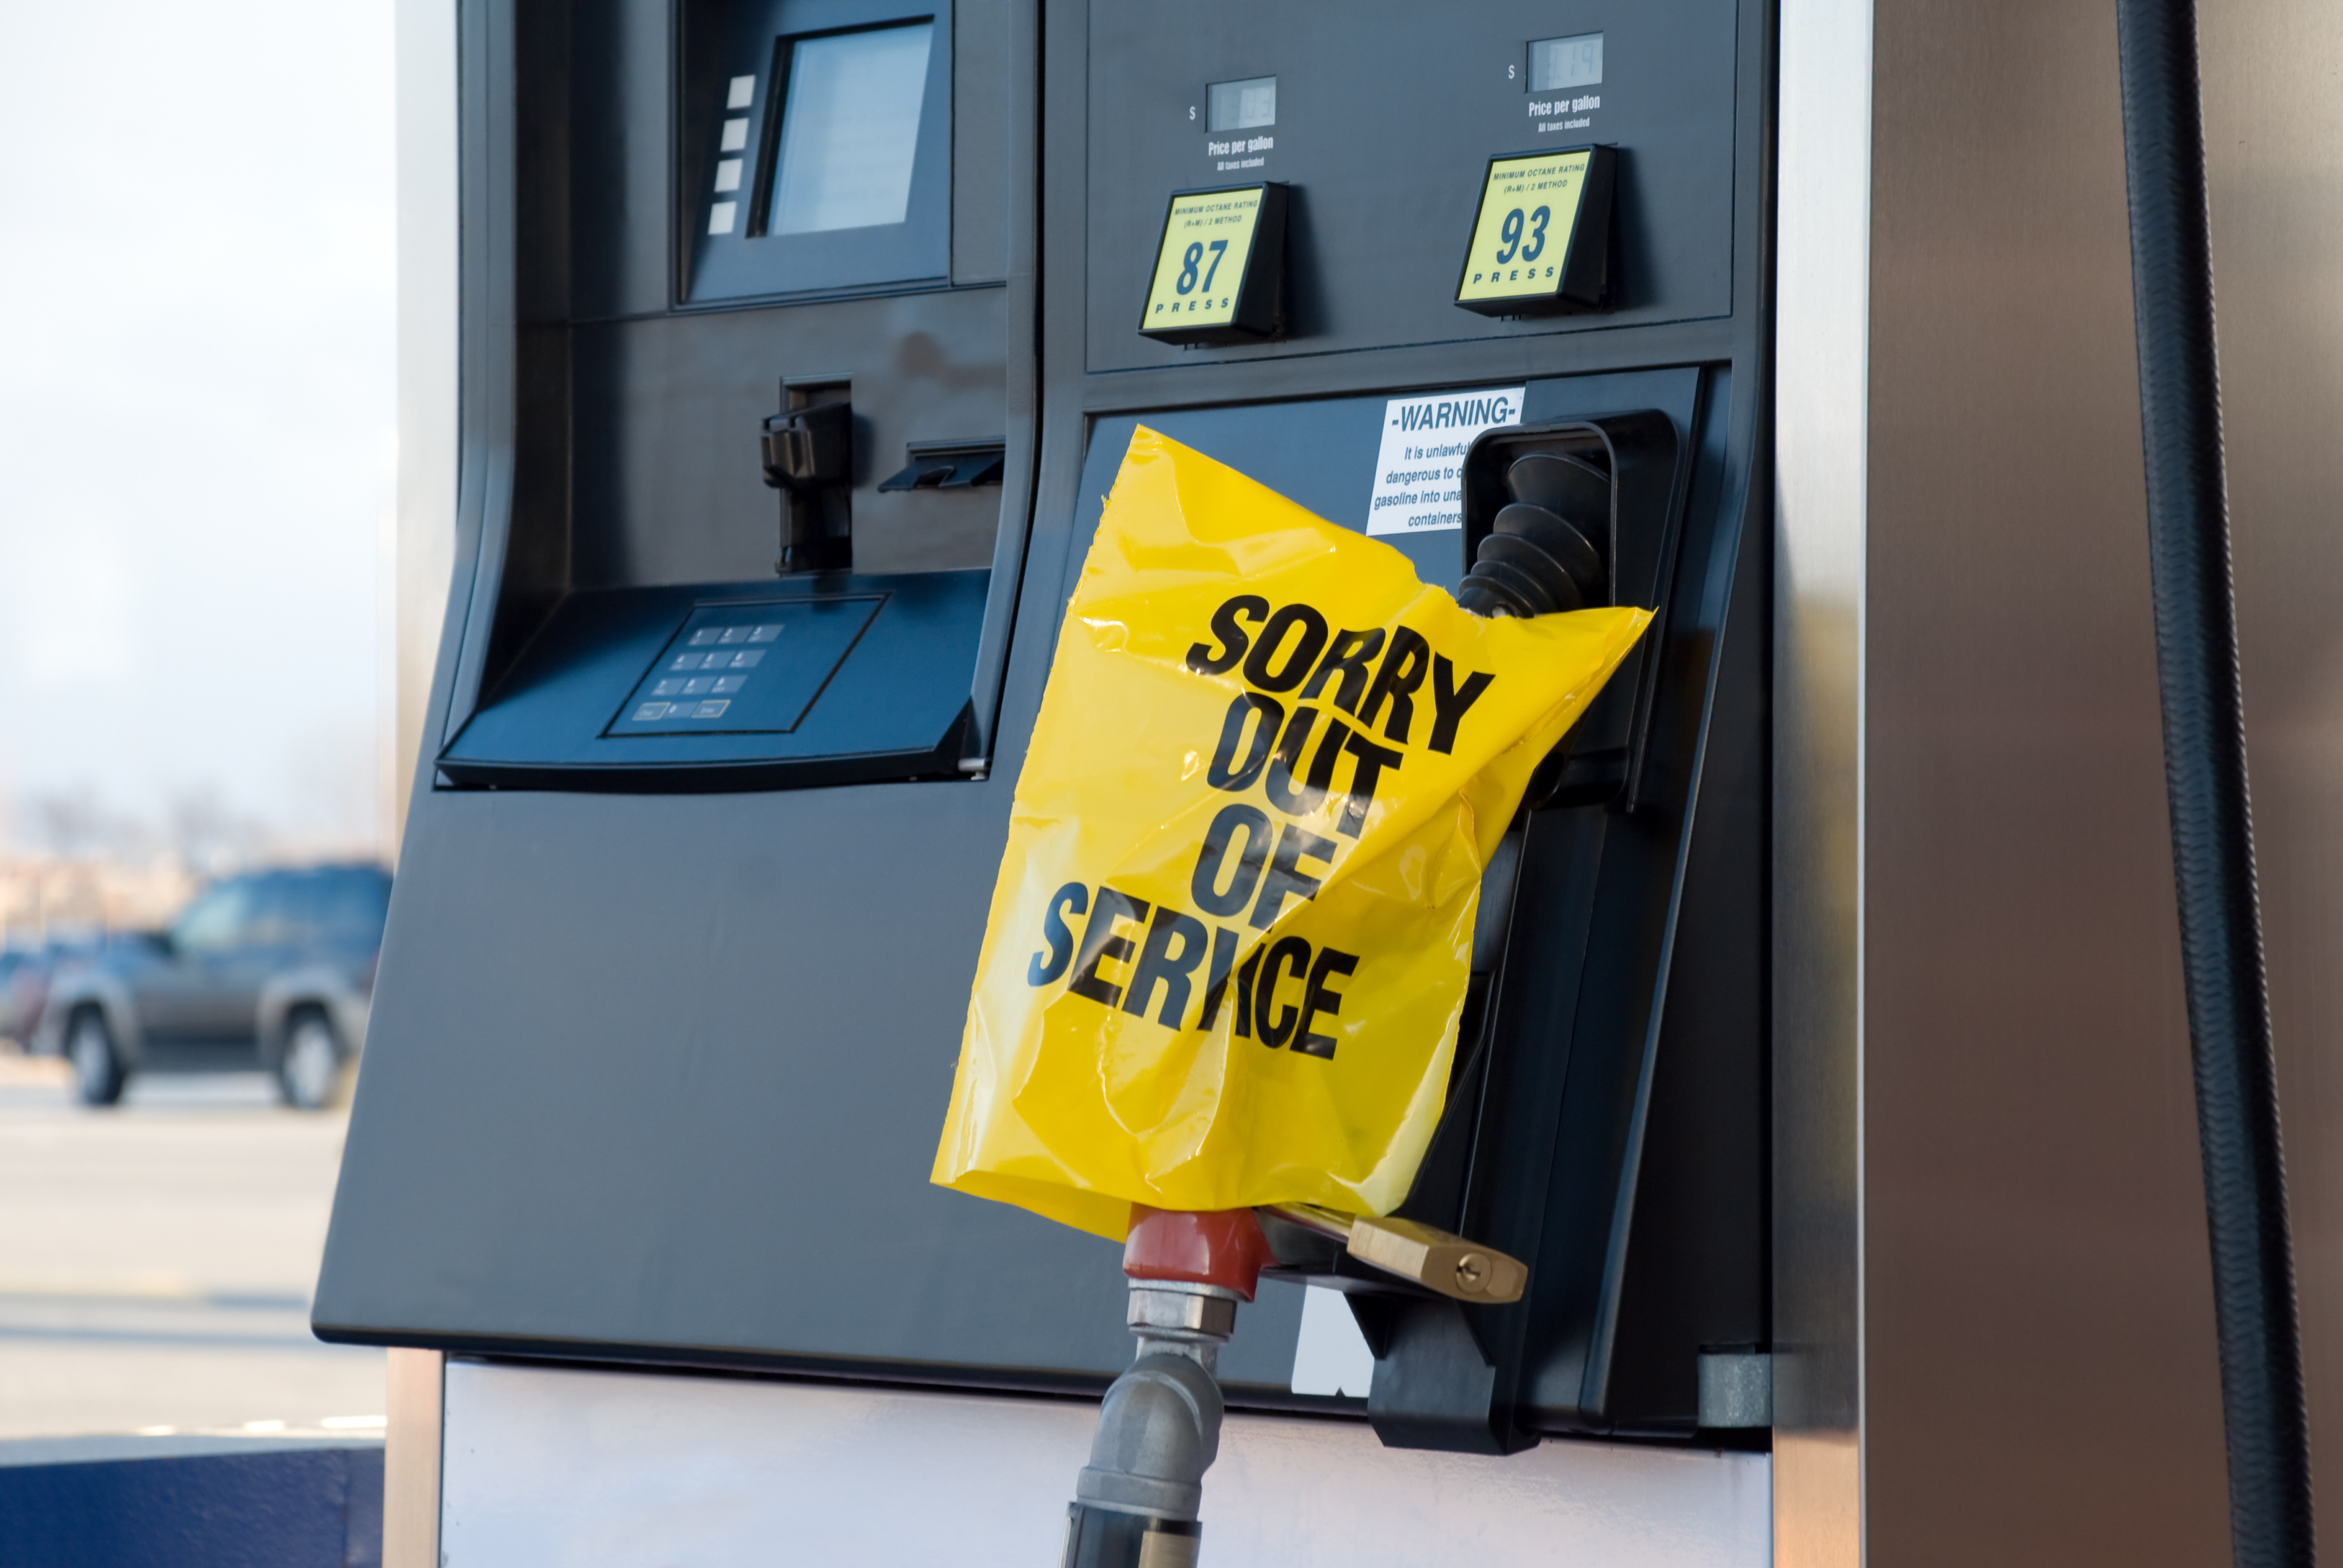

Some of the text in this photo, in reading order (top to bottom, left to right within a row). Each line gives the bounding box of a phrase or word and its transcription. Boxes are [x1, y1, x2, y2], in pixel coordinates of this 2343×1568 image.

[1529, 96, 1600, 117] Price per gallon
[1547, 120, 1563, 131] taxes
[1565, 117, 1590, 129] included
[1208, 136, 1273, 156] Price per gallon
[1225, 160, 1240, 170] taxes
[1240, 157, 1264, 168] included
[1493, 163, 1585, 180] MINIMUM OCTANE RATING
[1537, 180, 1567, 189] METHOD
[1175, 200, 1257, 215] MINIMUM OCTANE RATING
[1214, 215, 1242, 224] METHOD
[1496, 206, 1550, 264] 93
[1176, 240, 1228, 295] 87
[1473, 267, 1554, 284] PRESS
[1155, 298, 1229, 314] PRESS
[1404, 447, 1412, 460] It
[1414, 446, 1423, 459] is
[1386, 468, 1440, 486] dangerous
[1444, 466, 1453, 479] to
[1374, 491, 1417, 510] gasoline
[1420, 490, 1440, 503] into
[1408, 512, 1461, 527] containers
[1186, 595, 1496, 756] SORRY
[1207, 692, 1403, 839] OUT
[1190, 804, 1337, 934] OF
